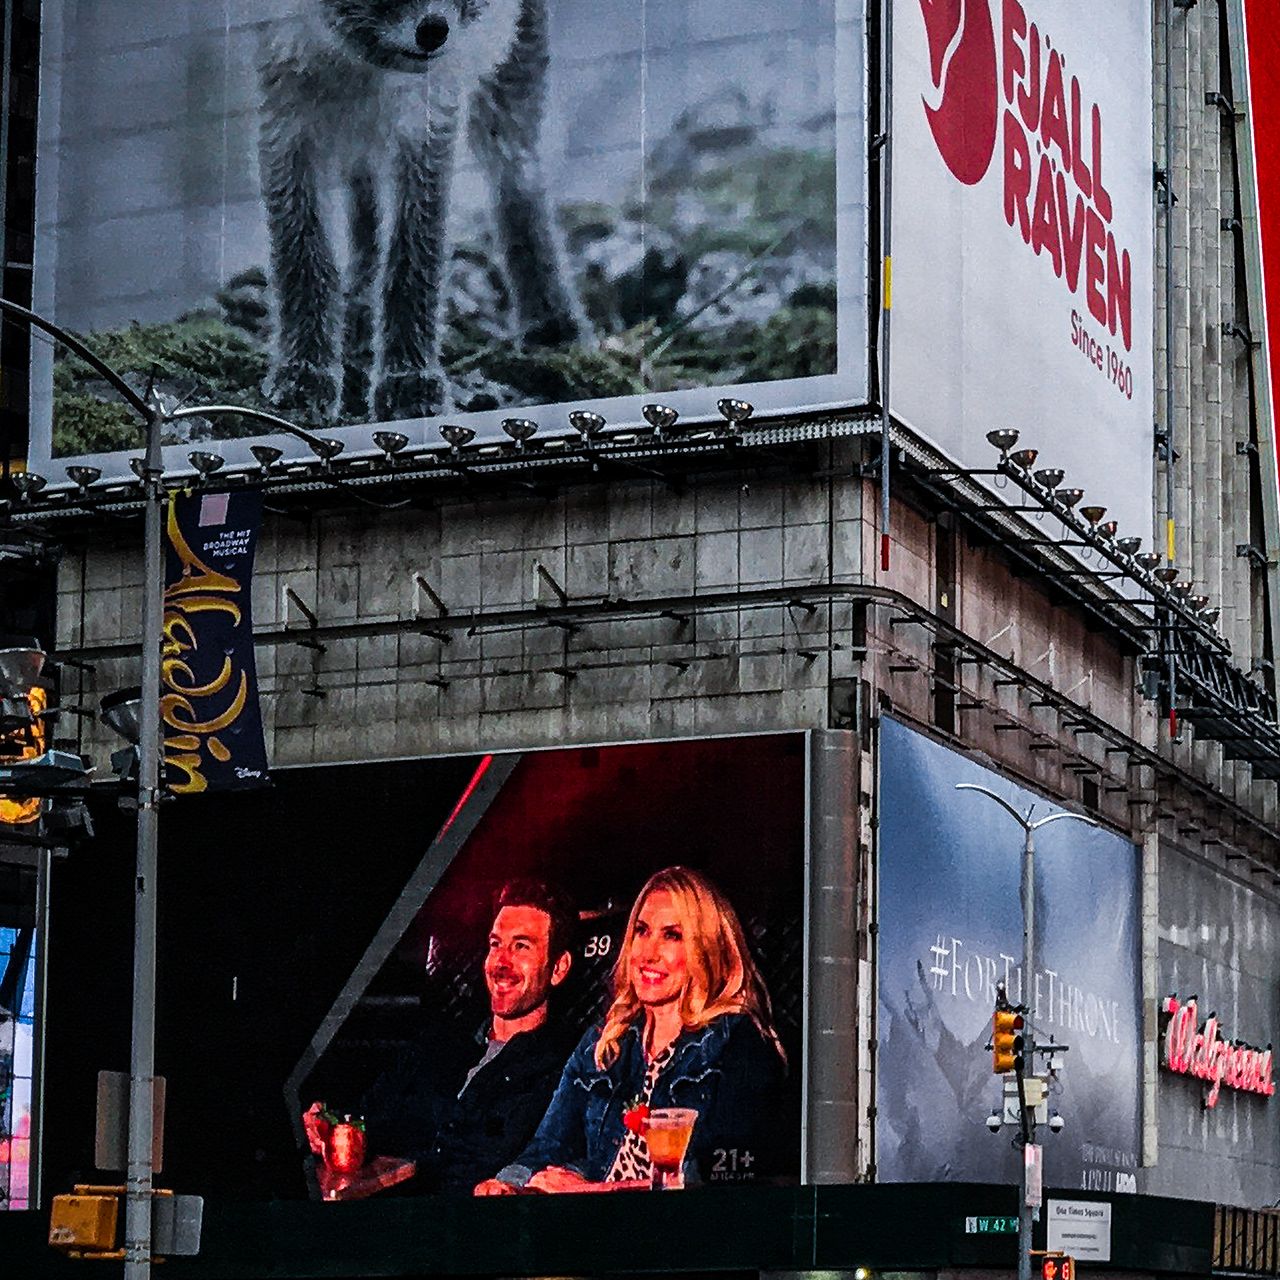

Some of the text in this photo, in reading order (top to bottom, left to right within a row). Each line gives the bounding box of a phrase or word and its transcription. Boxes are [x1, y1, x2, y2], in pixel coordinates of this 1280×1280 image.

[1071, 309, 1132, 400] Since 1960
[219, 531, 234, 540] THE
[203, 538, 250, 551] BROADWAY
[212, 547, 248, 557] MUSICAL
[712, 1148, 755, 1172] 21+
[992, 1219, 1005, 1232] 42
